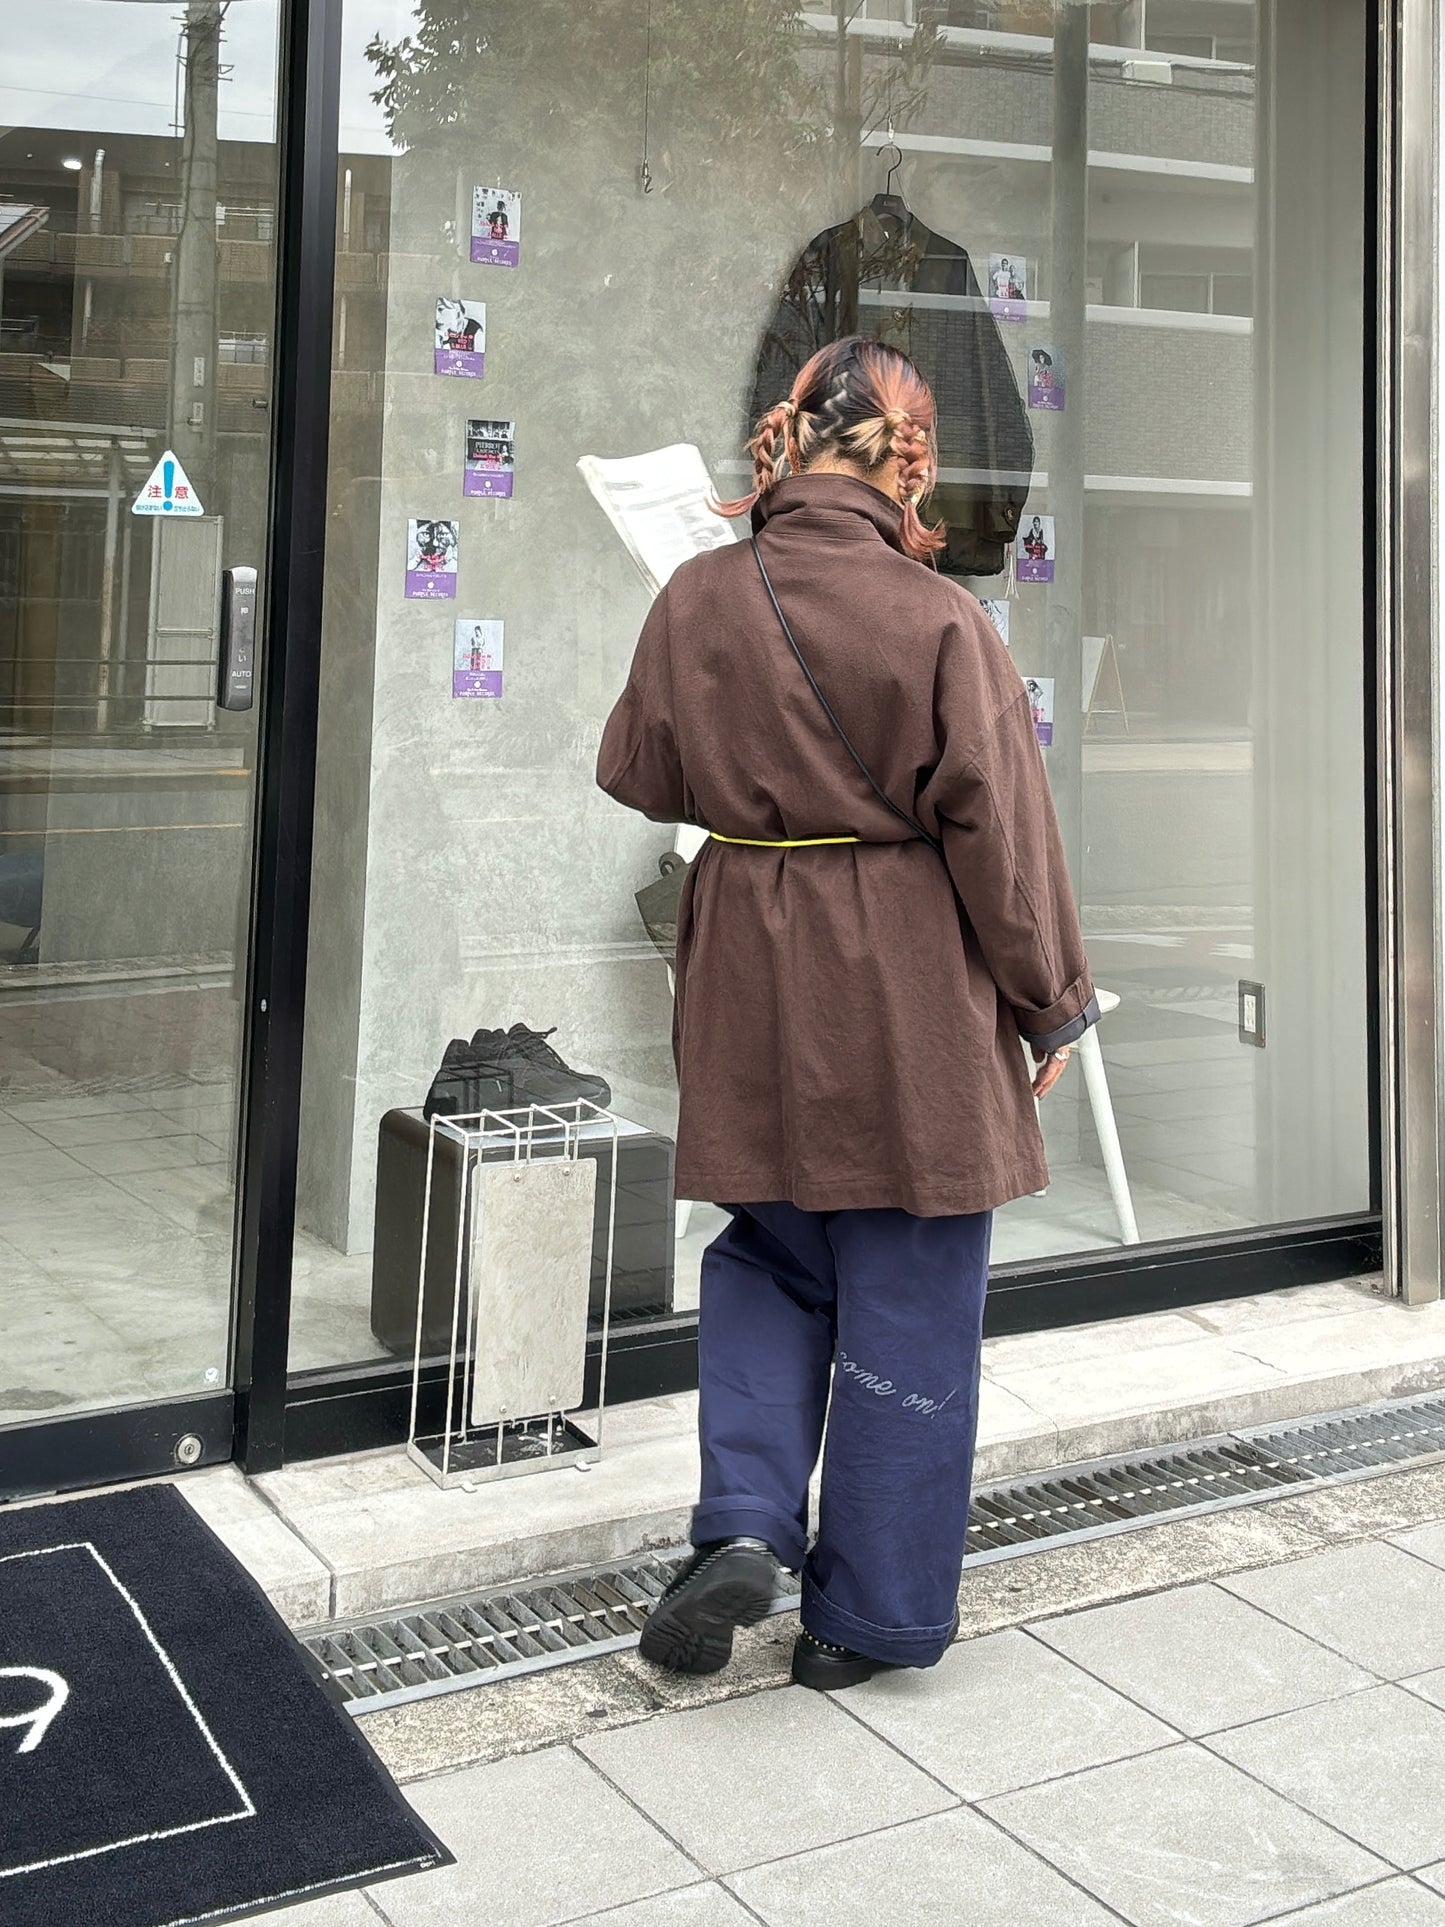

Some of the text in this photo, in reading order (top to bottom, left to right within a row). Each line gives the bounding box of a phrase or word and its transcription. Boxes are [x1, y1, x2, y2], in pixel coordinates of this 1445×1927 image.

[235, 587, 255, 595] PUSH
[231, 670, 252, 678] AUTO
[901, 1387, 957, 1419] on!
